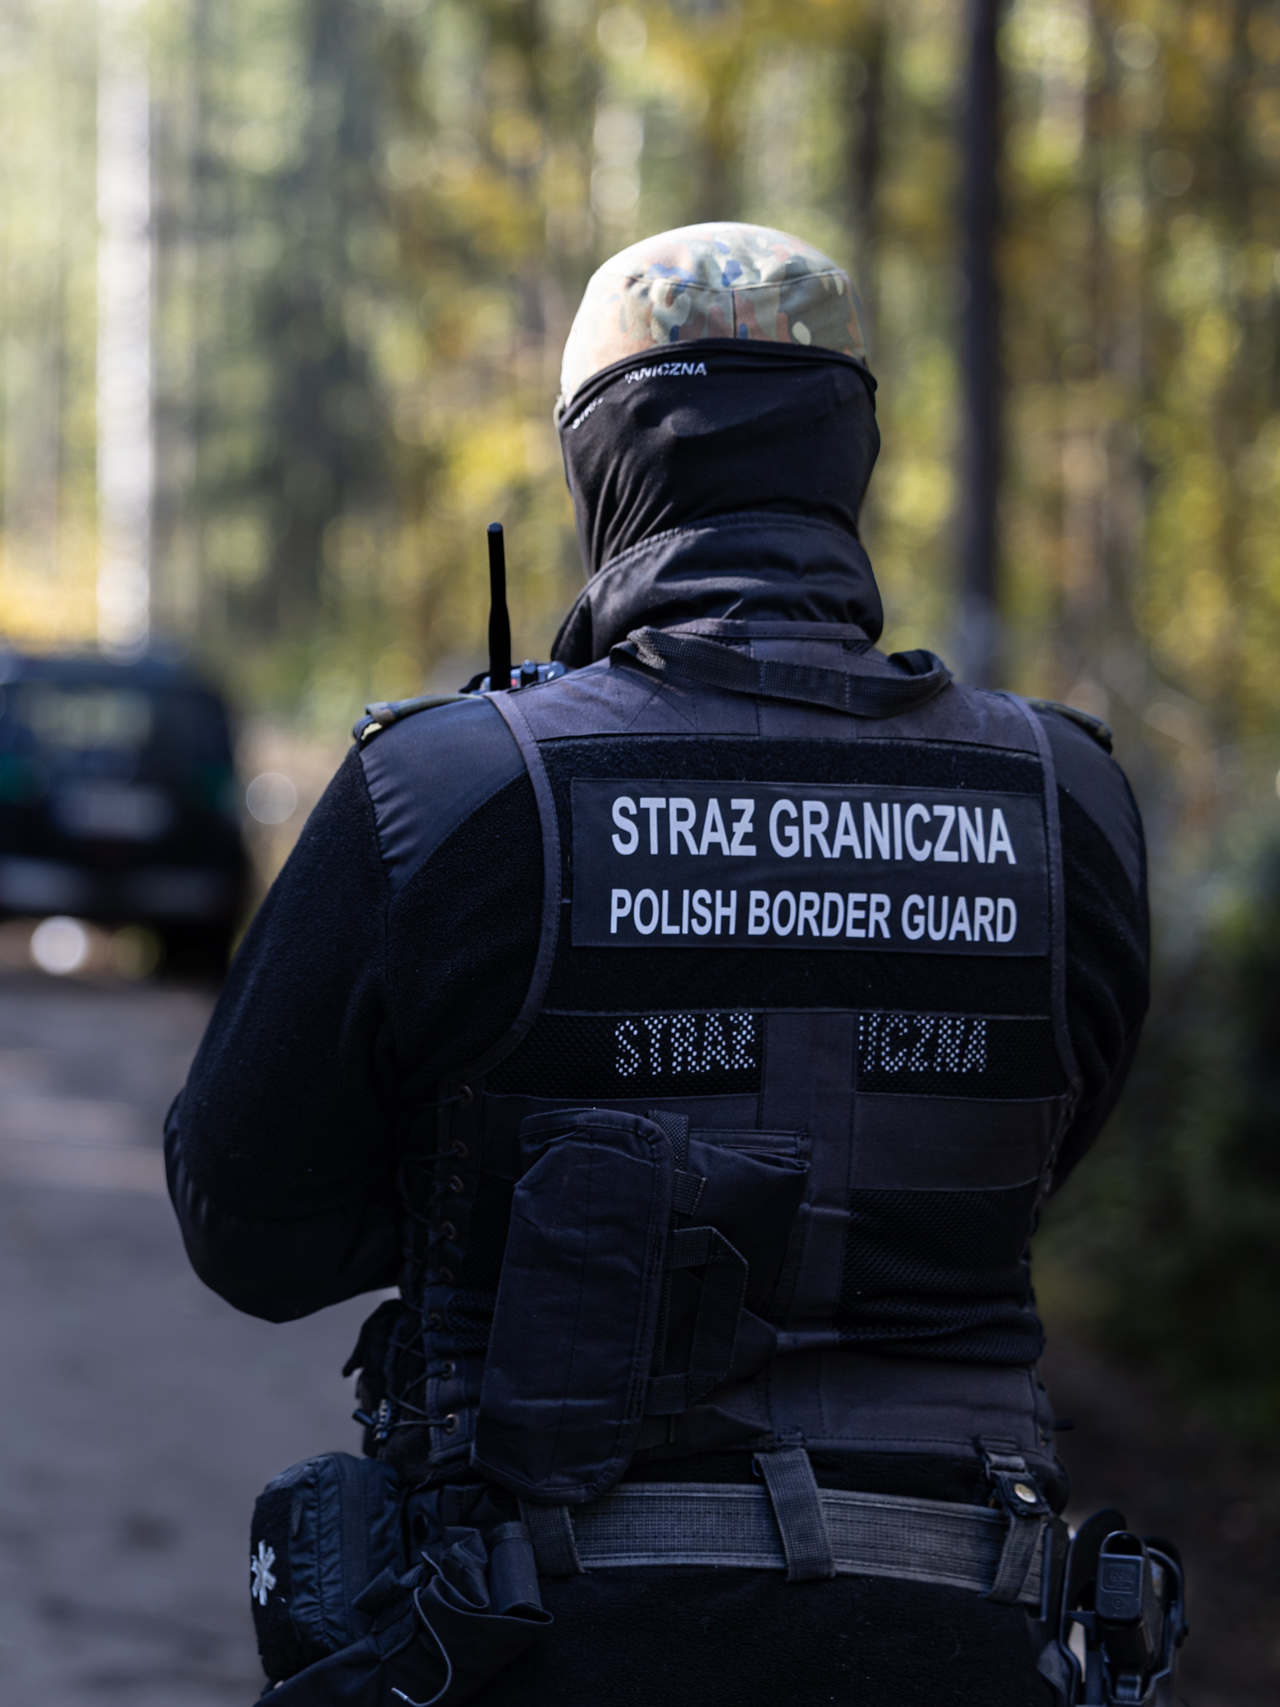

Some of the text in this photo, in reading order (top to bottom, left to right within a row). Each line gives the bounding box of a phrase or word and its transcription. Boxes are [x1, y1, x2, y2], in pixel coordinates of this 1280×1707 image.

[769, 799, 1016, 864] GRANICZNA
[611, 889, 1016, 942] POLISH BORDER GUARD
